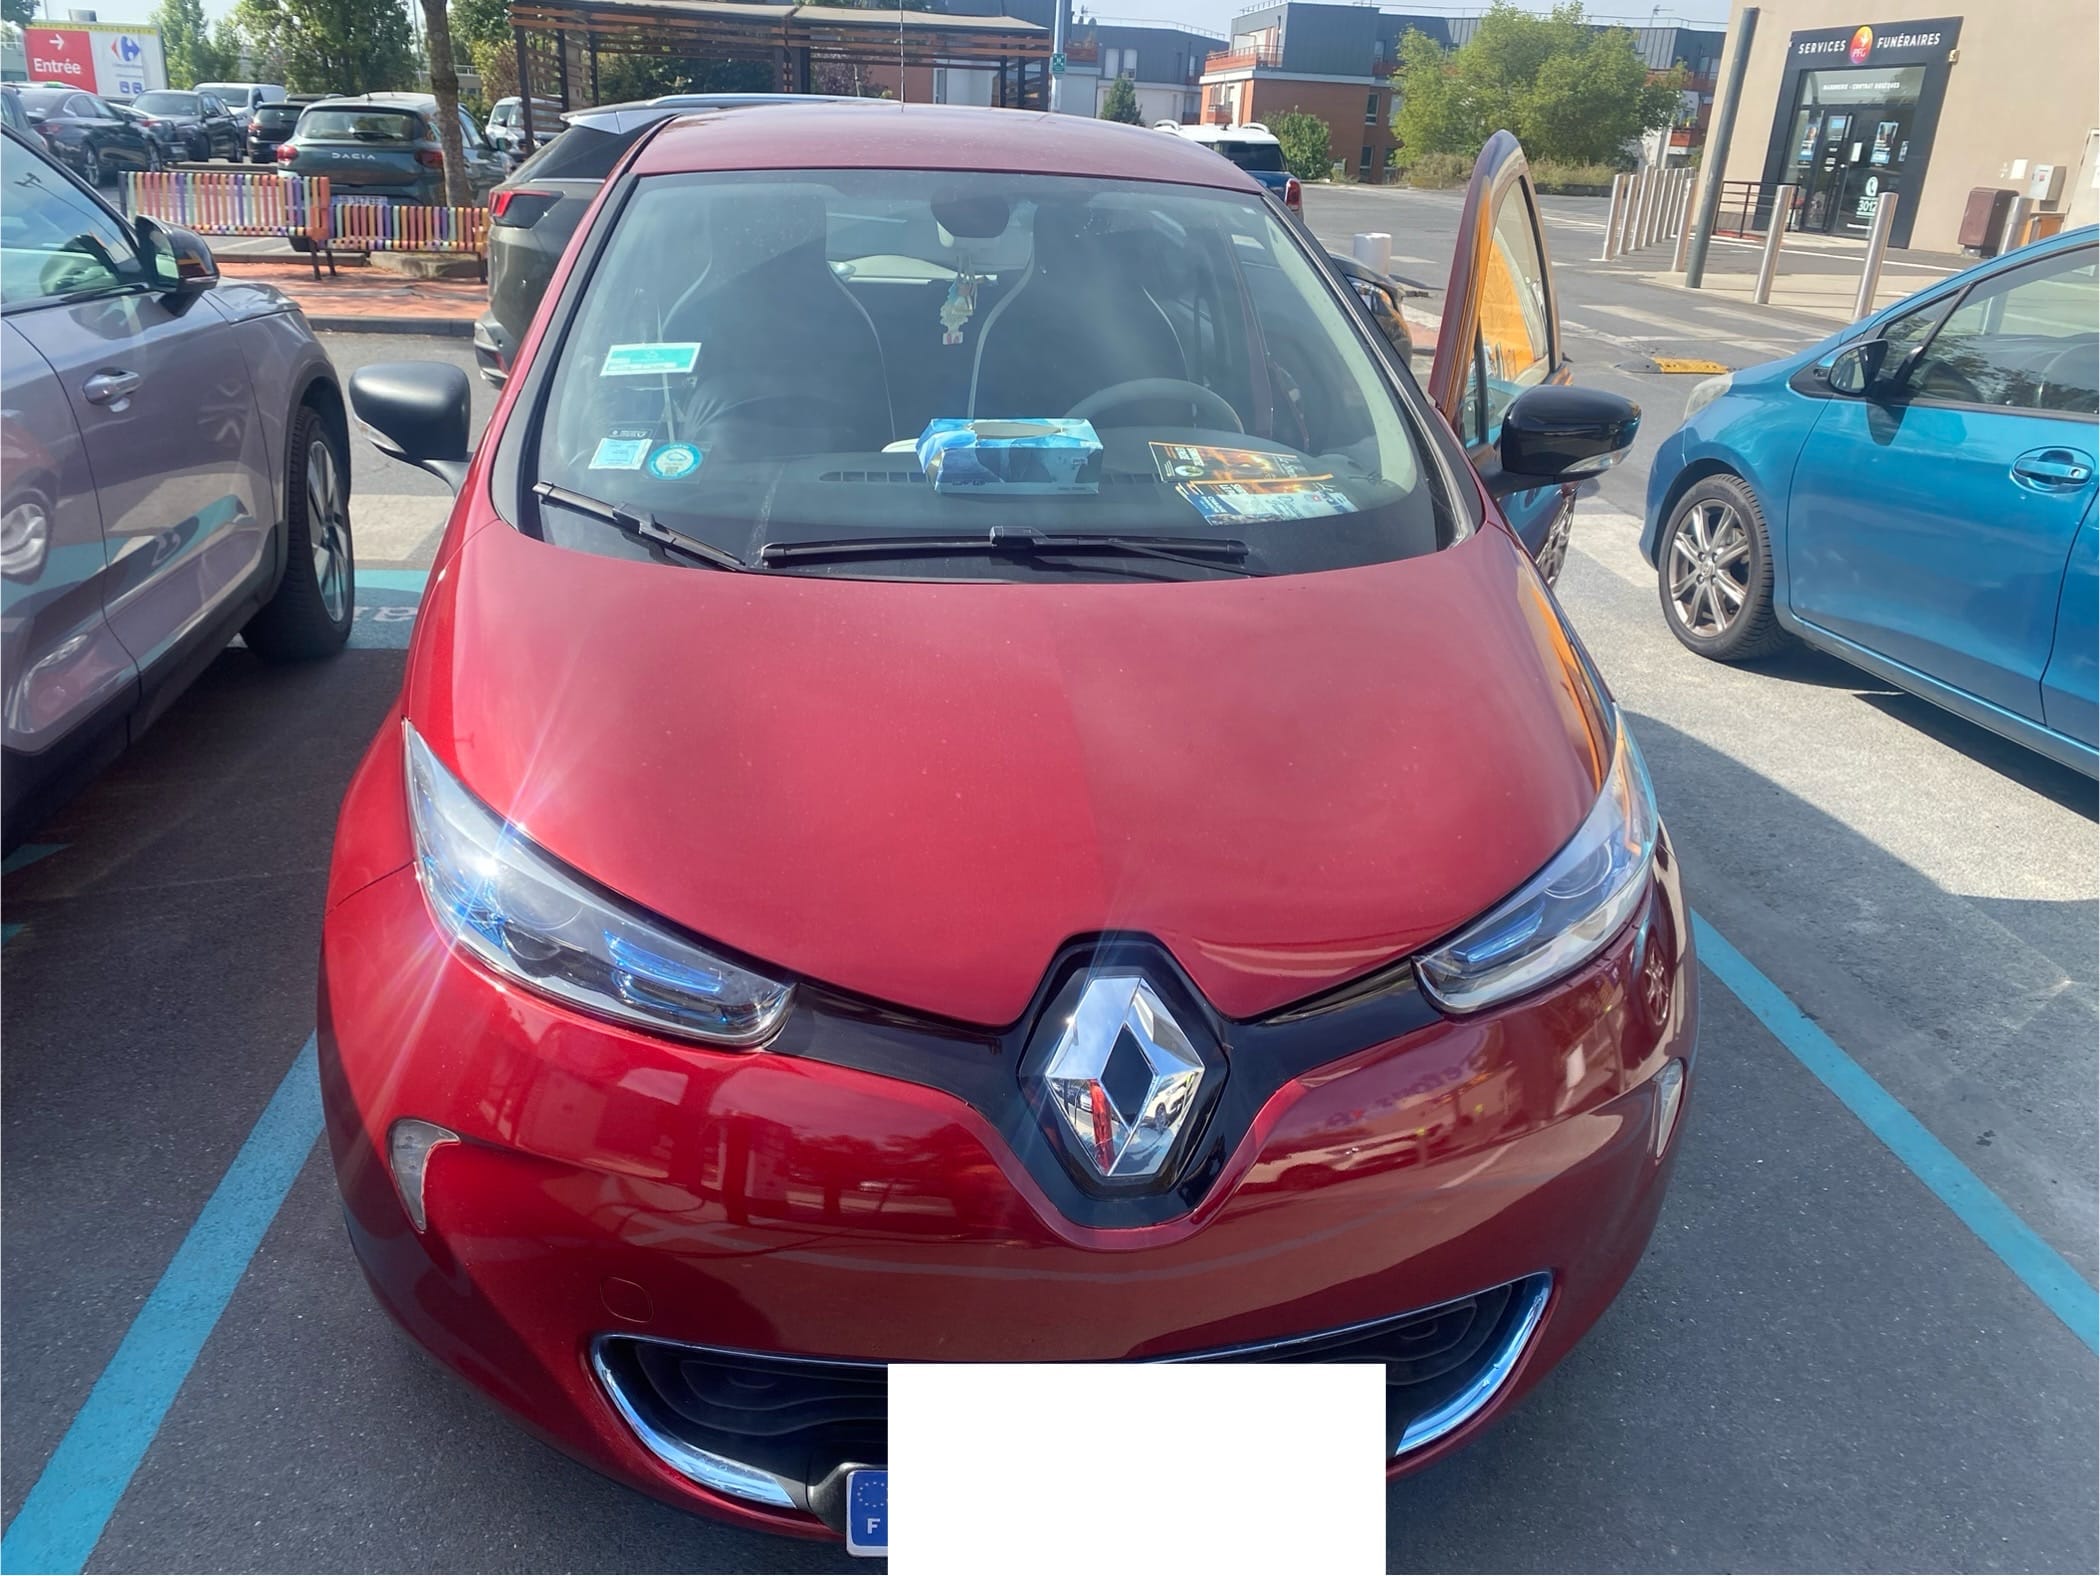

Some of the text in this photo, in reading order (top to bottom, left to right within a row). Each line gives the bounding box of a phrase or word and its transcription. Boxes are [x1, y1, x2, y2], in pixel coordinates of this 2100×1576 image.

[1798, 32, 1941, 54] SERVICES FUNÉRAIRES
[1851, 47, 1866, 58] PFG
[33, 57, 82, 75] Entrée
[331, 152, 376, 160] DACIA
[867, 1518, 881, 1534] F
